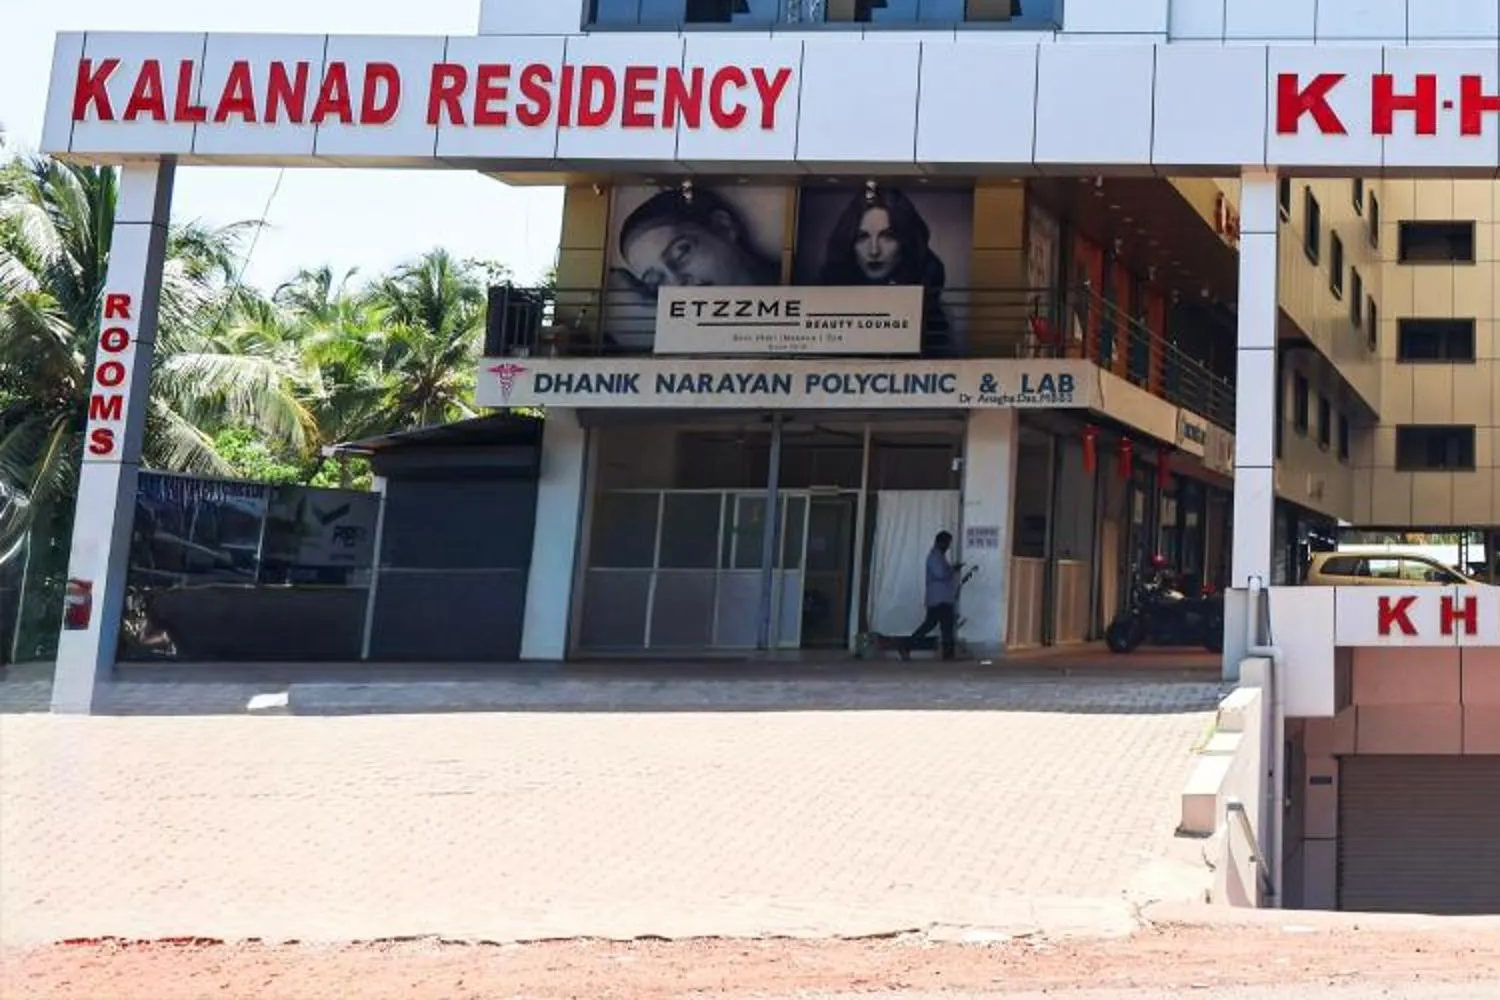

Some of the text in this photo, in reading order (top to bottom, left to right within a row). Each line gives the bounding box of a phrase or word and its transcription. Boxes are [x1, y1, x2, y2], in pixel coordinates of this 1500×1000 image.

[72, 58, 792, 130] KALANAD RESIDENCY
[669, 299, 802, 318] ETZZME
[805, 319, 909, 329] BEAUTY LOUNGE
[88, 293, 132, 456] ROOMS
[533, 372, 1075, 396] DHANIK NARAYAN POLYCLINIC & LAB
[1378, 596, 1418, 636] K
[1440, 596, 1477, 636] H
